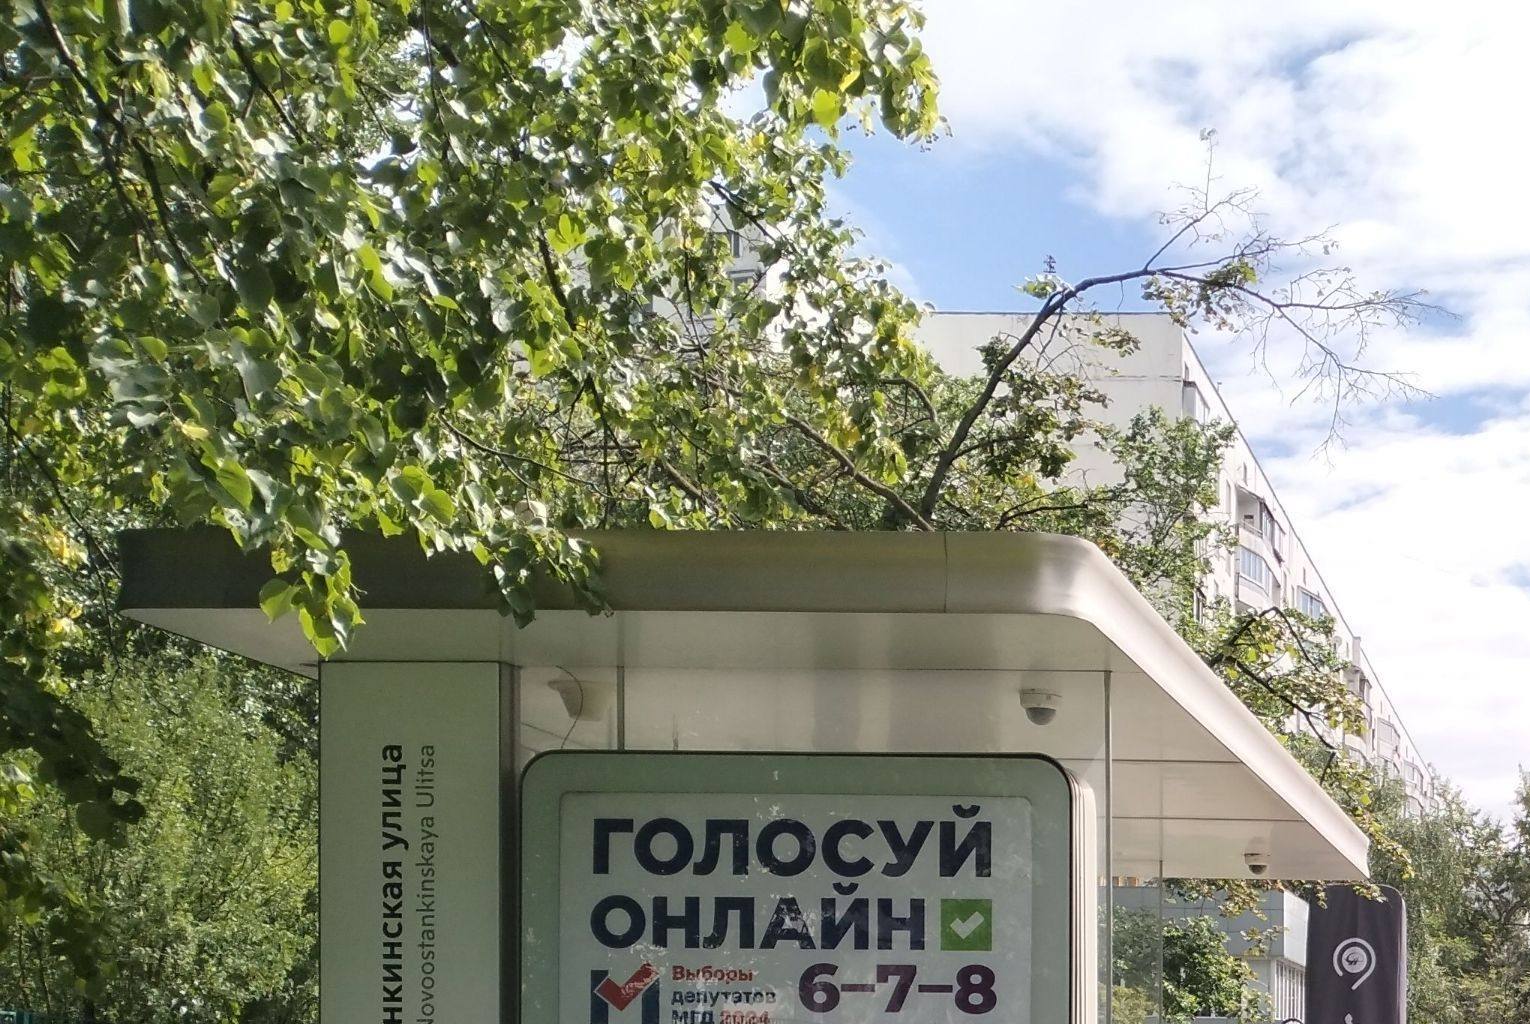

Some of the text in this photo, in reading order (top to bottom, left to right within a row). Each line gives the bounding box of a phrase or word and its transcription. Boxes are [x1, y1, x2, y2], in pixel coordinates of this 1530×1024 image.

[381, 744, 410, 850] улица
[416, 744, 435, 808] Ulitsa
[592, 804, 992, 878] ГОЛОСУЙ
[590, 882, 926, 951] ОНЛАЙН
[671, 990, 776, 1007] депутатов
[672, 965, 753, 984] Выборы
